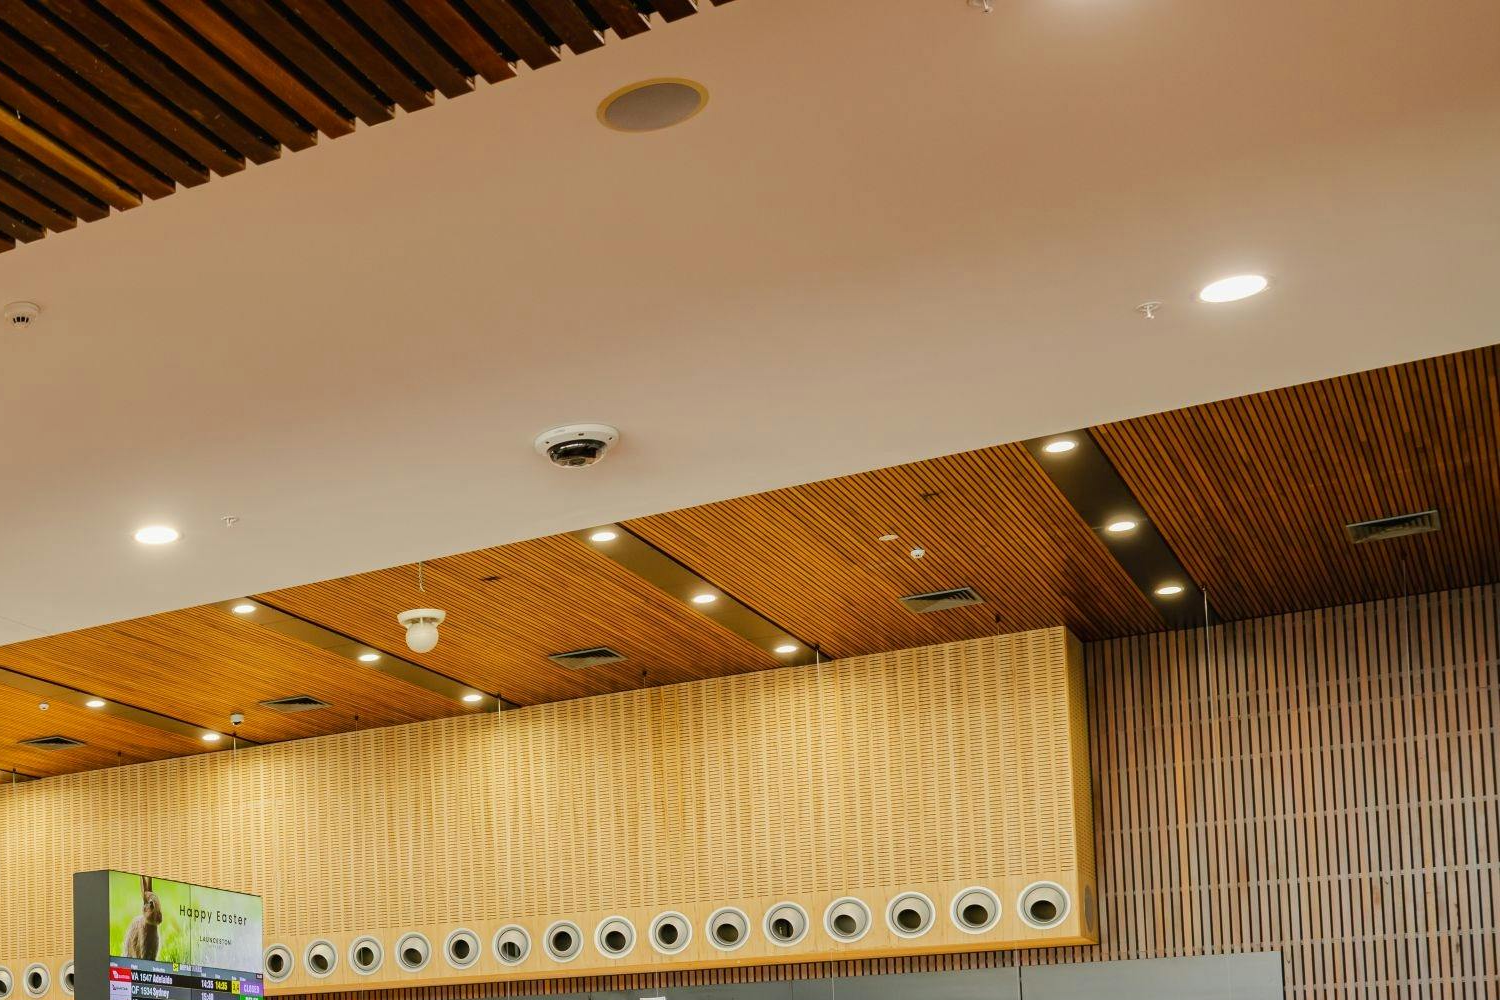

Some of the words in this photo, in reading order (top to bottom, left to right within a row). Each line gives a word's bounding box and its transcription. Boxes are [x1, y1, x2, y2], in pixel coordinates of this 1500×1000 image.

[179, 904, 212, 925] Happy
[217, 910, 247, 926] Easter
[152, 974, 173, 985] Adelaide
[152, 988, 170, 999] Sydney
